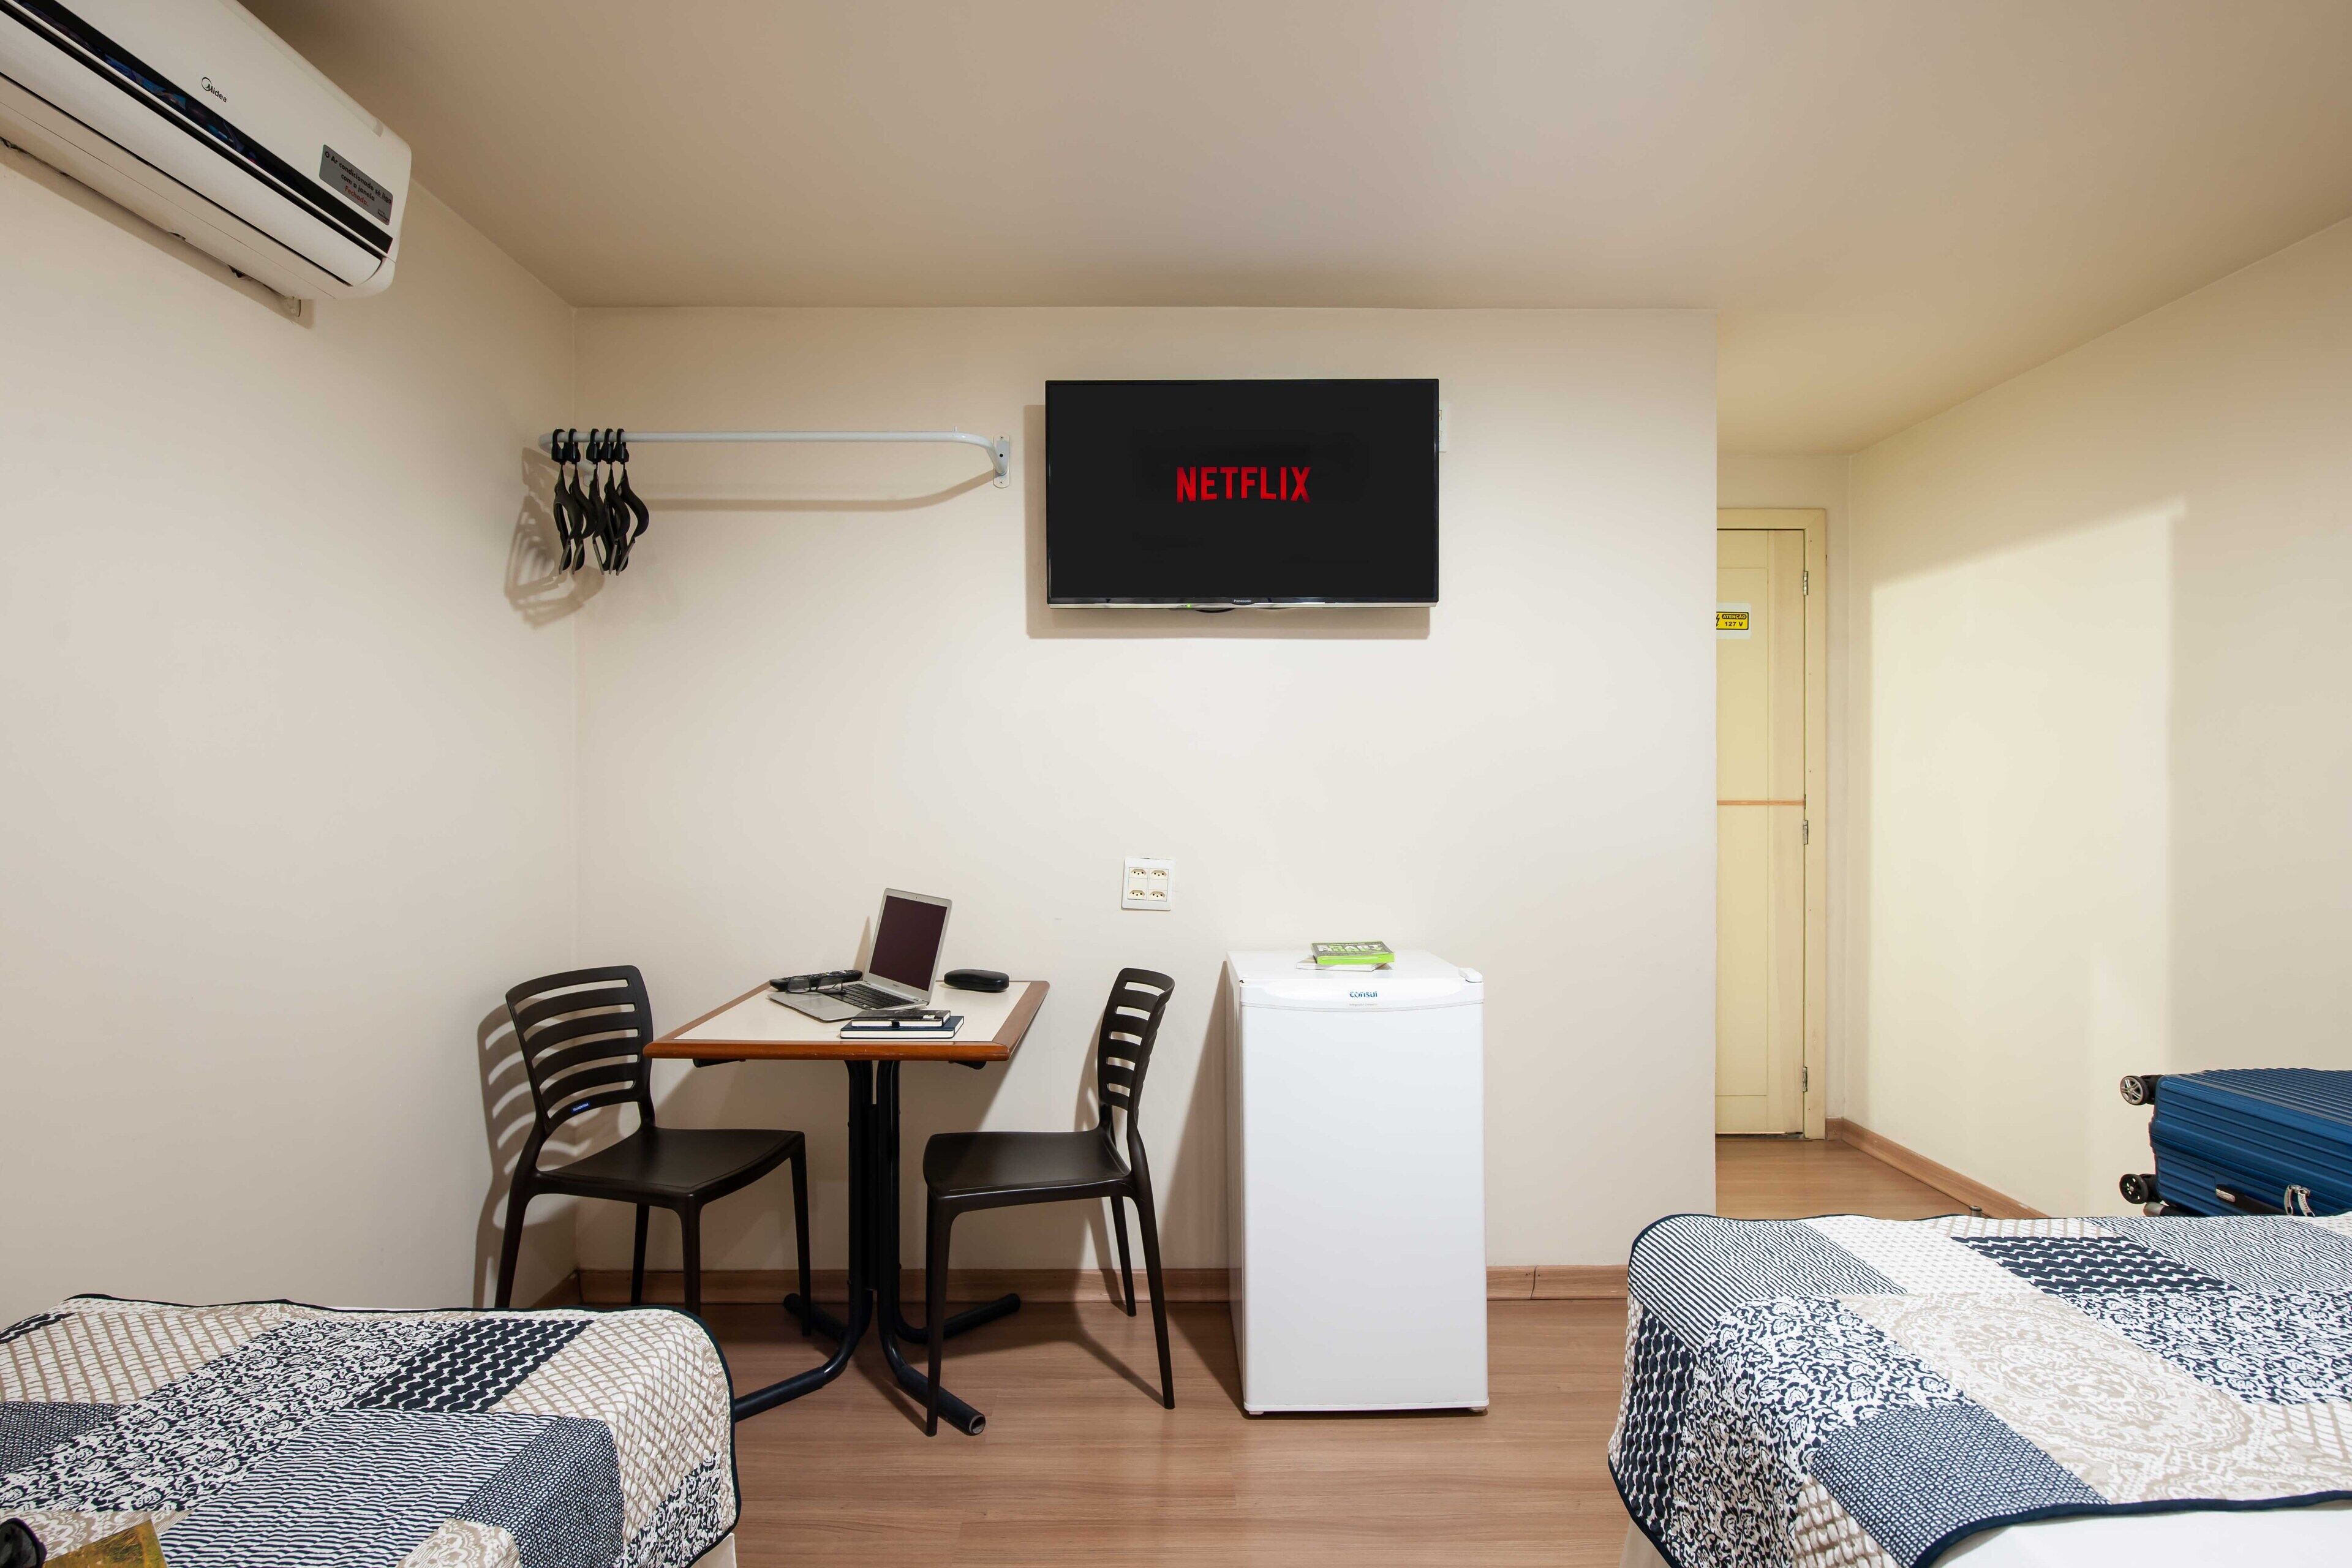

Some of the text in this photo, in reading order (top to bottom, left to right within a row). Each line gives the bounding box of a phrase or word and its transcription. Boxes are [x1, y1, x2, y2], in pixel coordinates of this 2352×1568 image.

[203, 81, 227, 102] Midea
[331, 156, 337, 164] Ar
[339, 162, 374, 190] condicionado
[382, 192, 391, 204] liga
[341, 174, 352, 184] com
[358, 184, 375, 201] janela
[1177, 466, 1311, 503] NETFLIX
